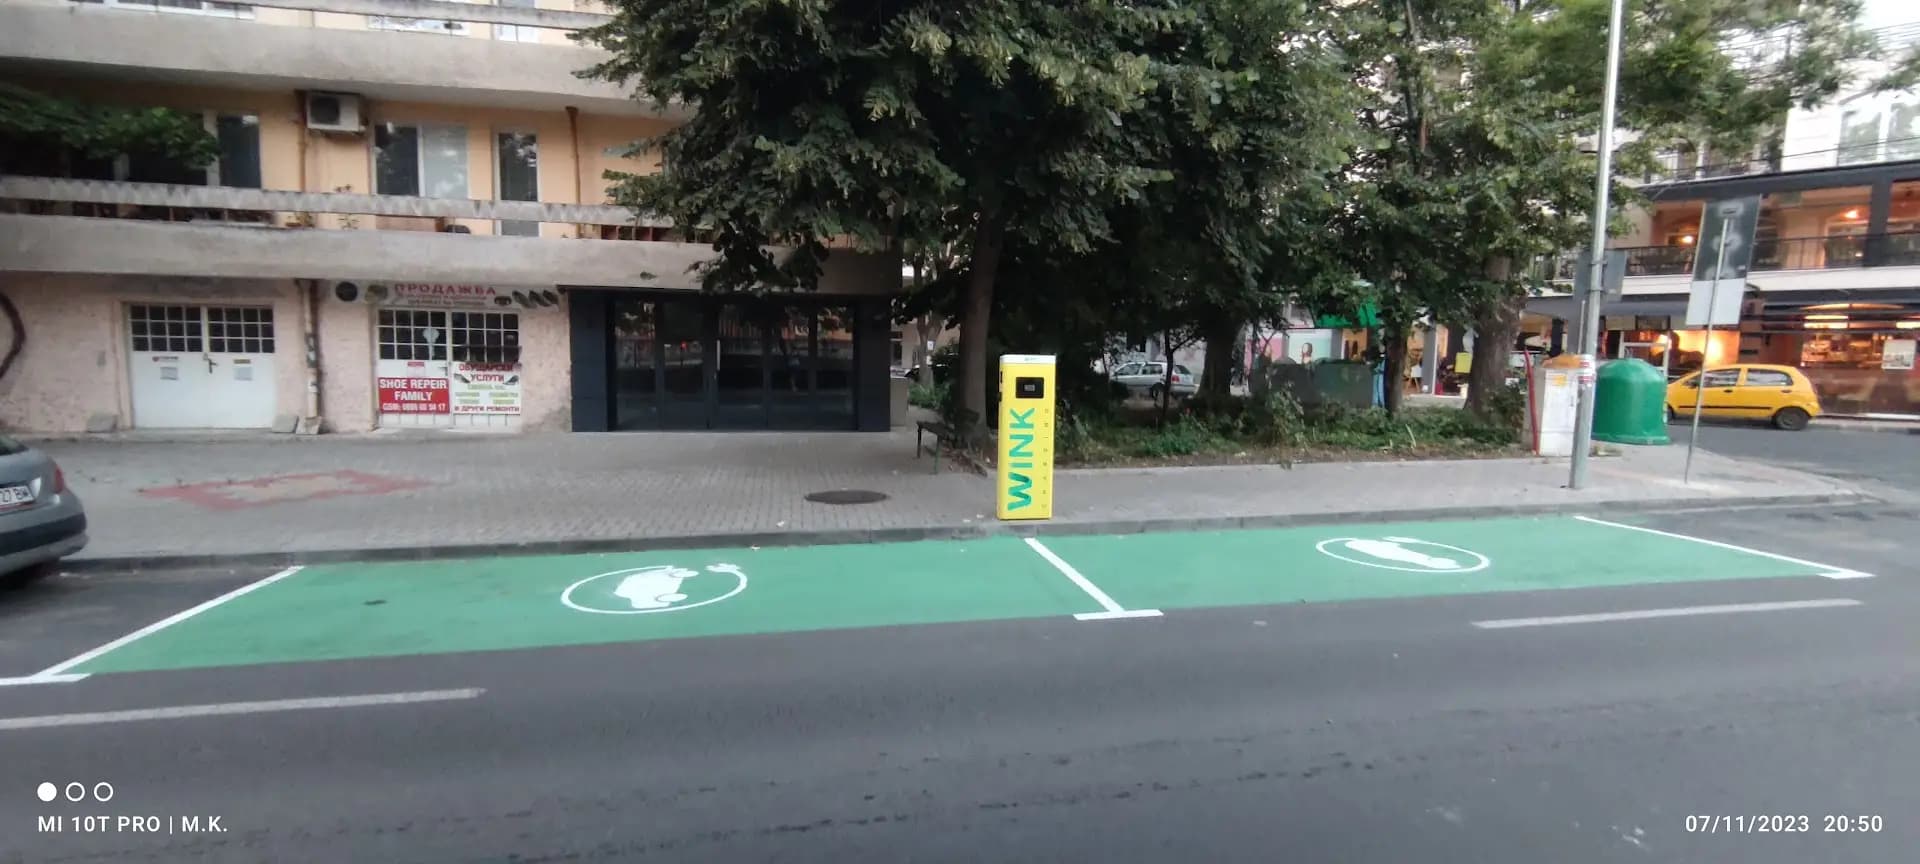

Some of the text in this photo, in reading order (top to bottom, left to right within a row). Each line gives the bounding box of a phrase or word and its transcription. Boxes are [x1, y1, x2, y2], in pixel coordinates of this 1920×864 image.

[394, 284, 496, 295] ПРОДАЖБА
[471, 374, 504, 382] УСЛУГИ
[380, 379, 447, 389] SHOE REPEIR
[394, 391, 433, 401] FAMILY
[1007, 407, 1035, 511] WINK
